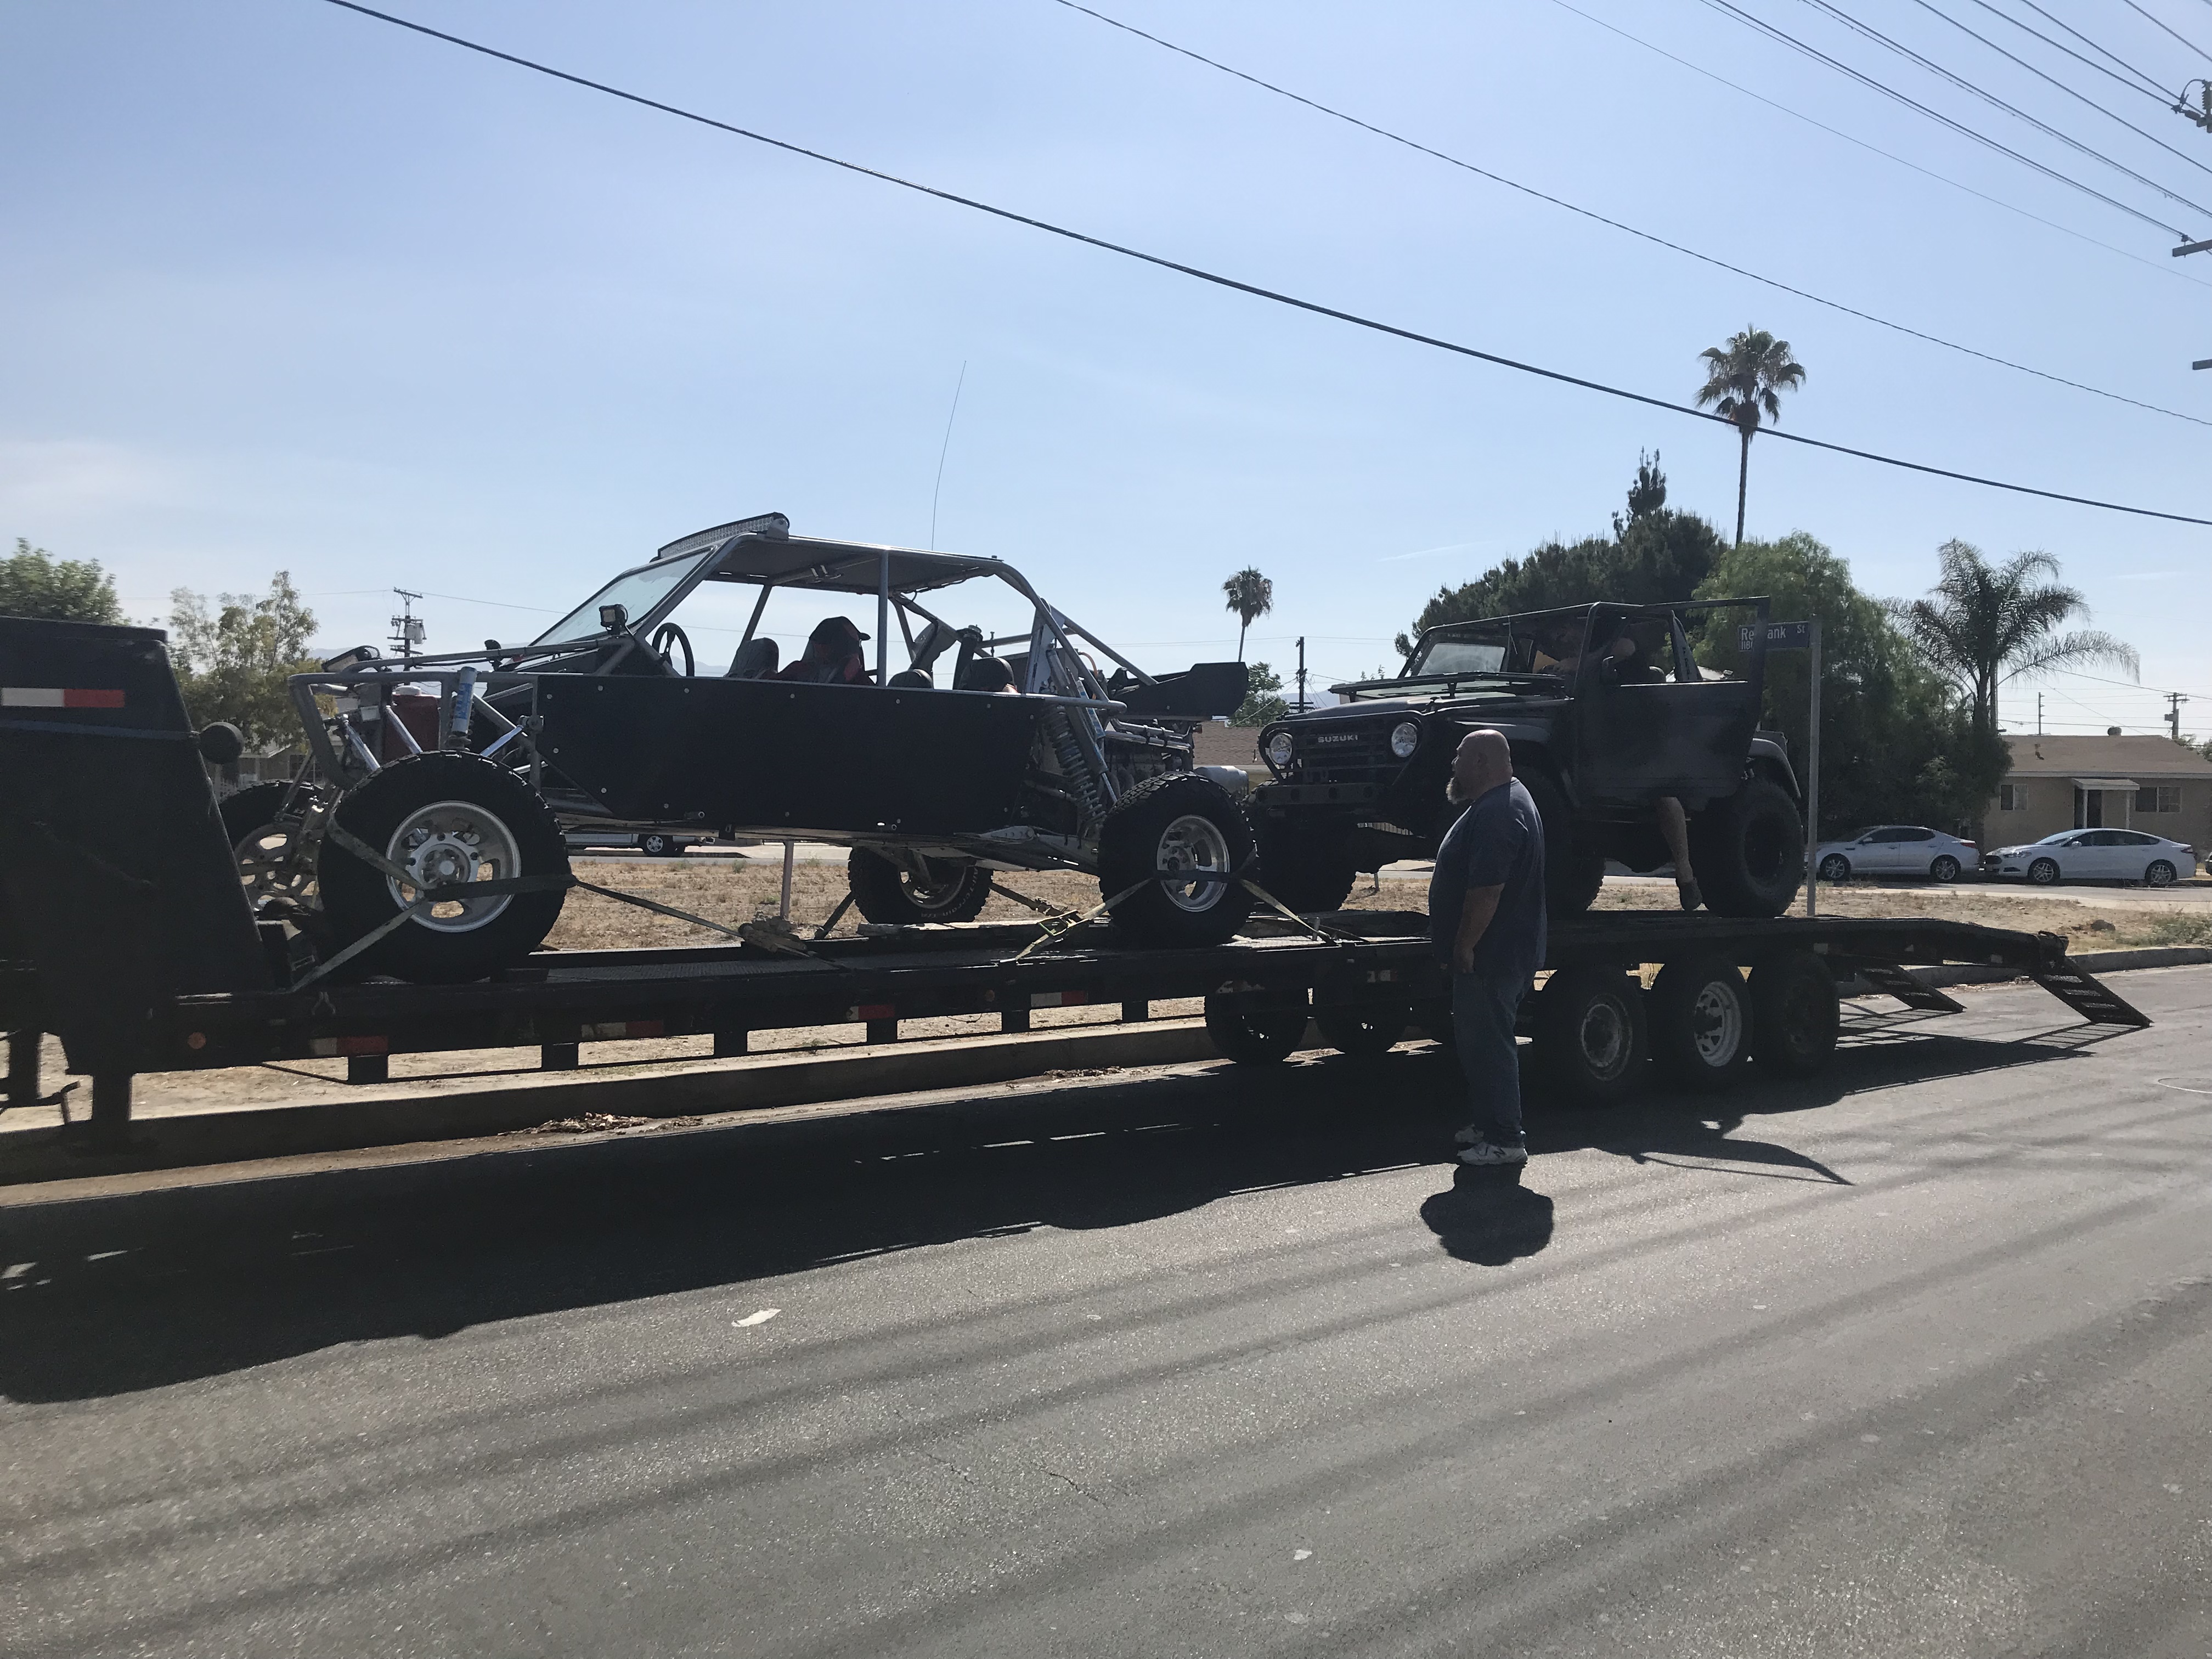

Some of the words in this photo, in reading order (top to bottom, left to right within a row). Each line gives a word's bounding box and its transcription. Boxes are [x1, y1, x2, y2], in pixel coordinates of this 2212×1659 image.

[1741, 626, 1786, 641] Reank
[1797, 624, 1805, 634] St
[1317, 734, 1358, 743] SUZUKI
